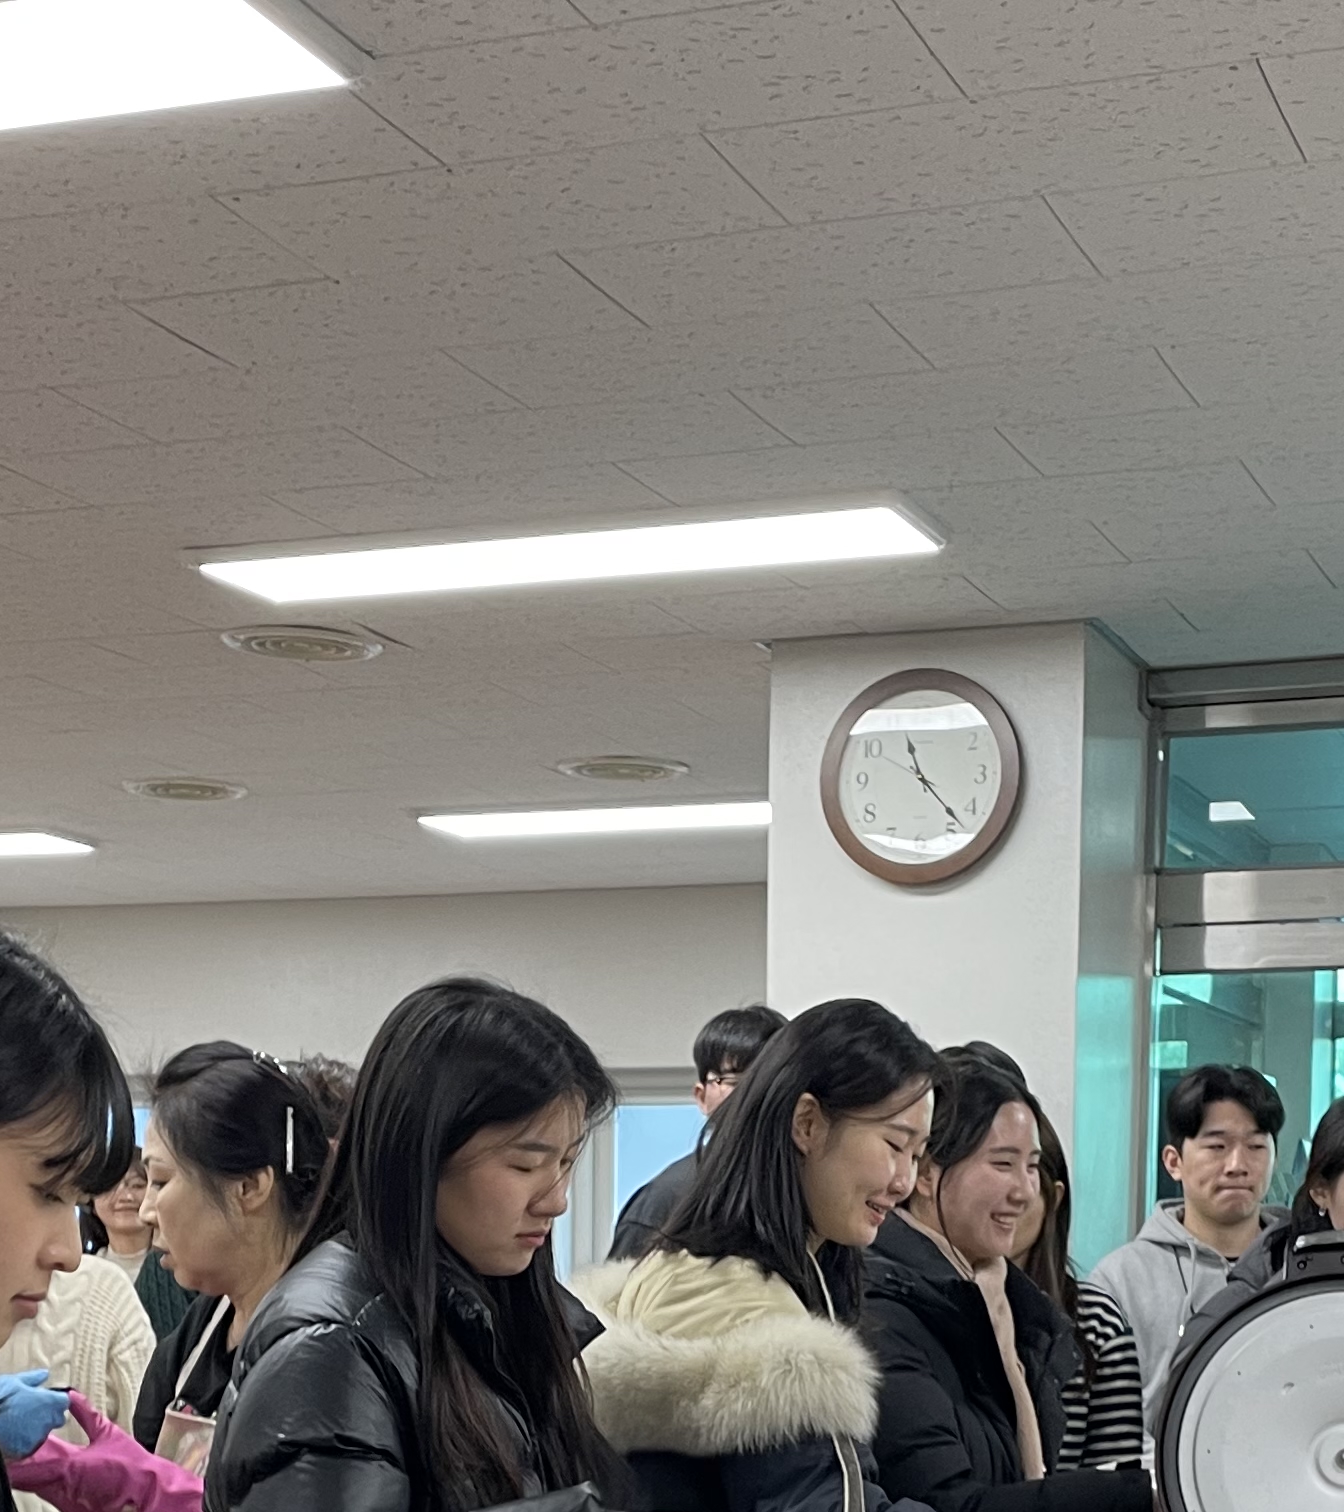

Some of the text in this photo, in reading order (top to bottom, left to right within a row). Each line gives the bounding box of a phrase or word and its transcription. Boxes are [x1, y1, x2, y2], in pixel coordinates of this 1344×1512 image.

[863, 738, 882, 758] 10
[966, 732, 978, 751] 2
[856, 771, 869, 791] 9
[973, 764, 987, 784] 3
[863, 803, 877, 823] 8
[964, 797, 977, 816] 4
